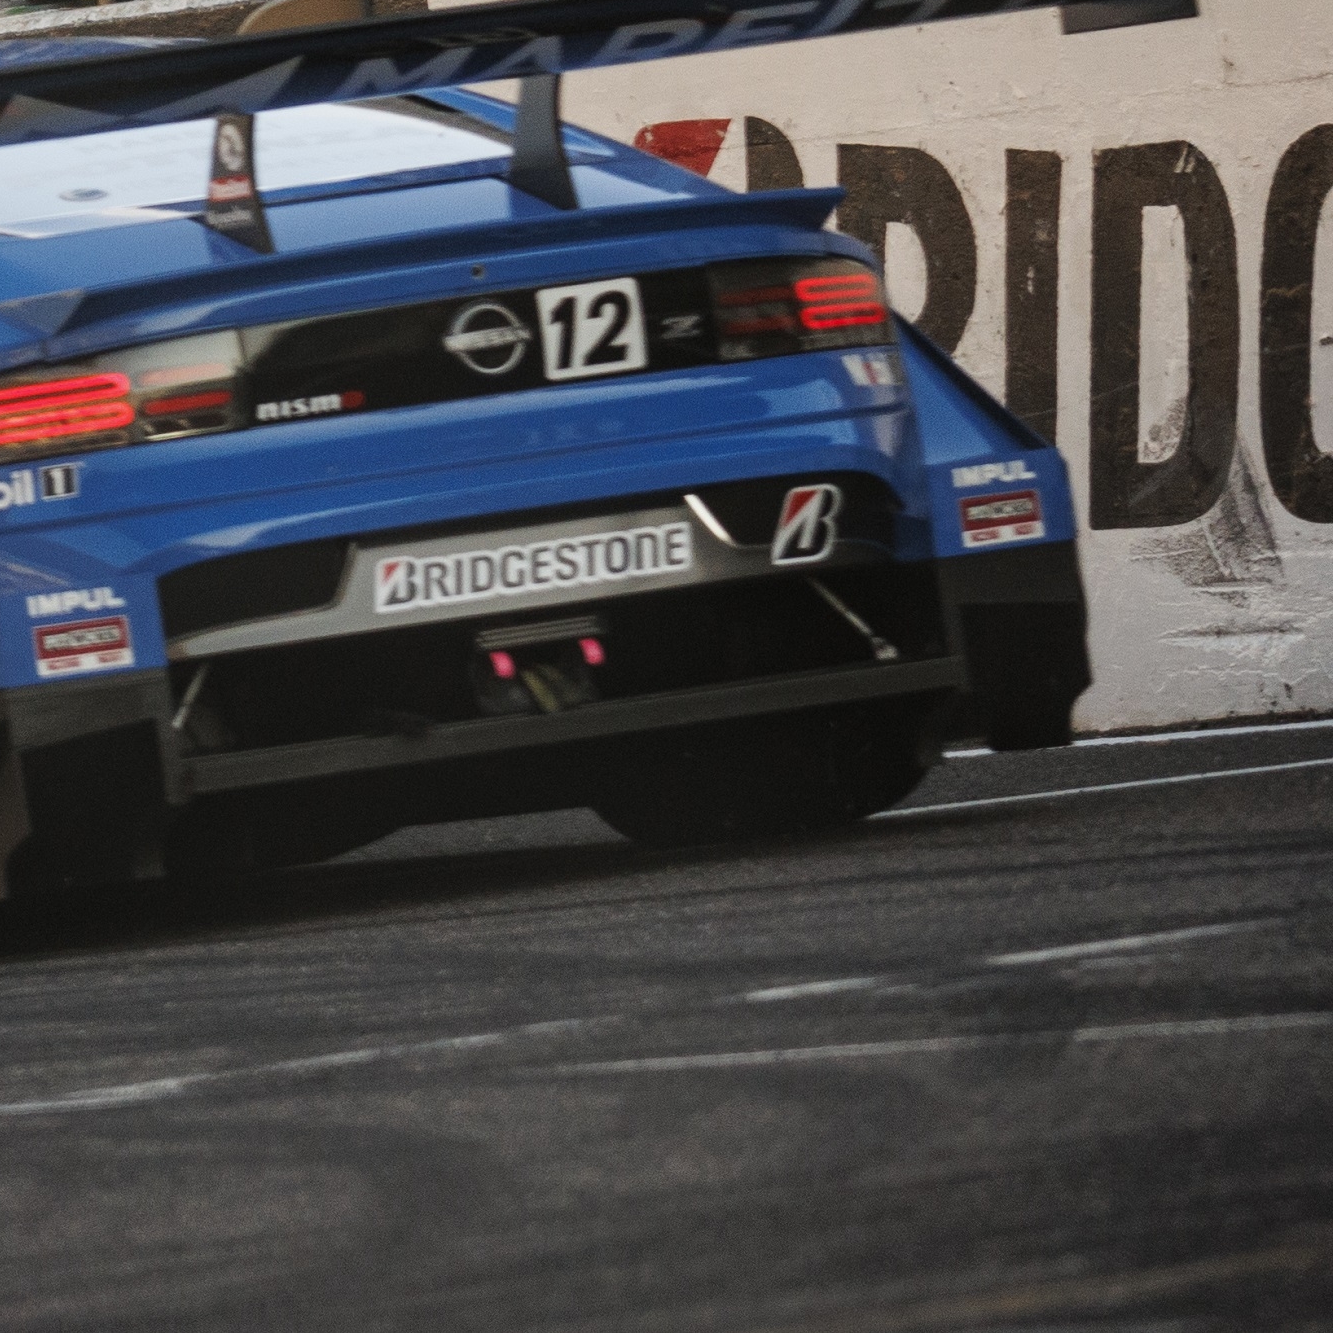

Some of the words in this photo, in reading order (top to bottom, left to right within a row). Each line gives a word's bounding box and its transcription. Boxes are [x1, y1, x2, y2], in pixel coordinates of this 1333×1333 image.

[548, 289, 633, 371] 12
[255, 390, 367, 423] nismo
[380, 525, 690, 608] BRIDGESTONE
[25, 585, 127, 618] IMPUL
